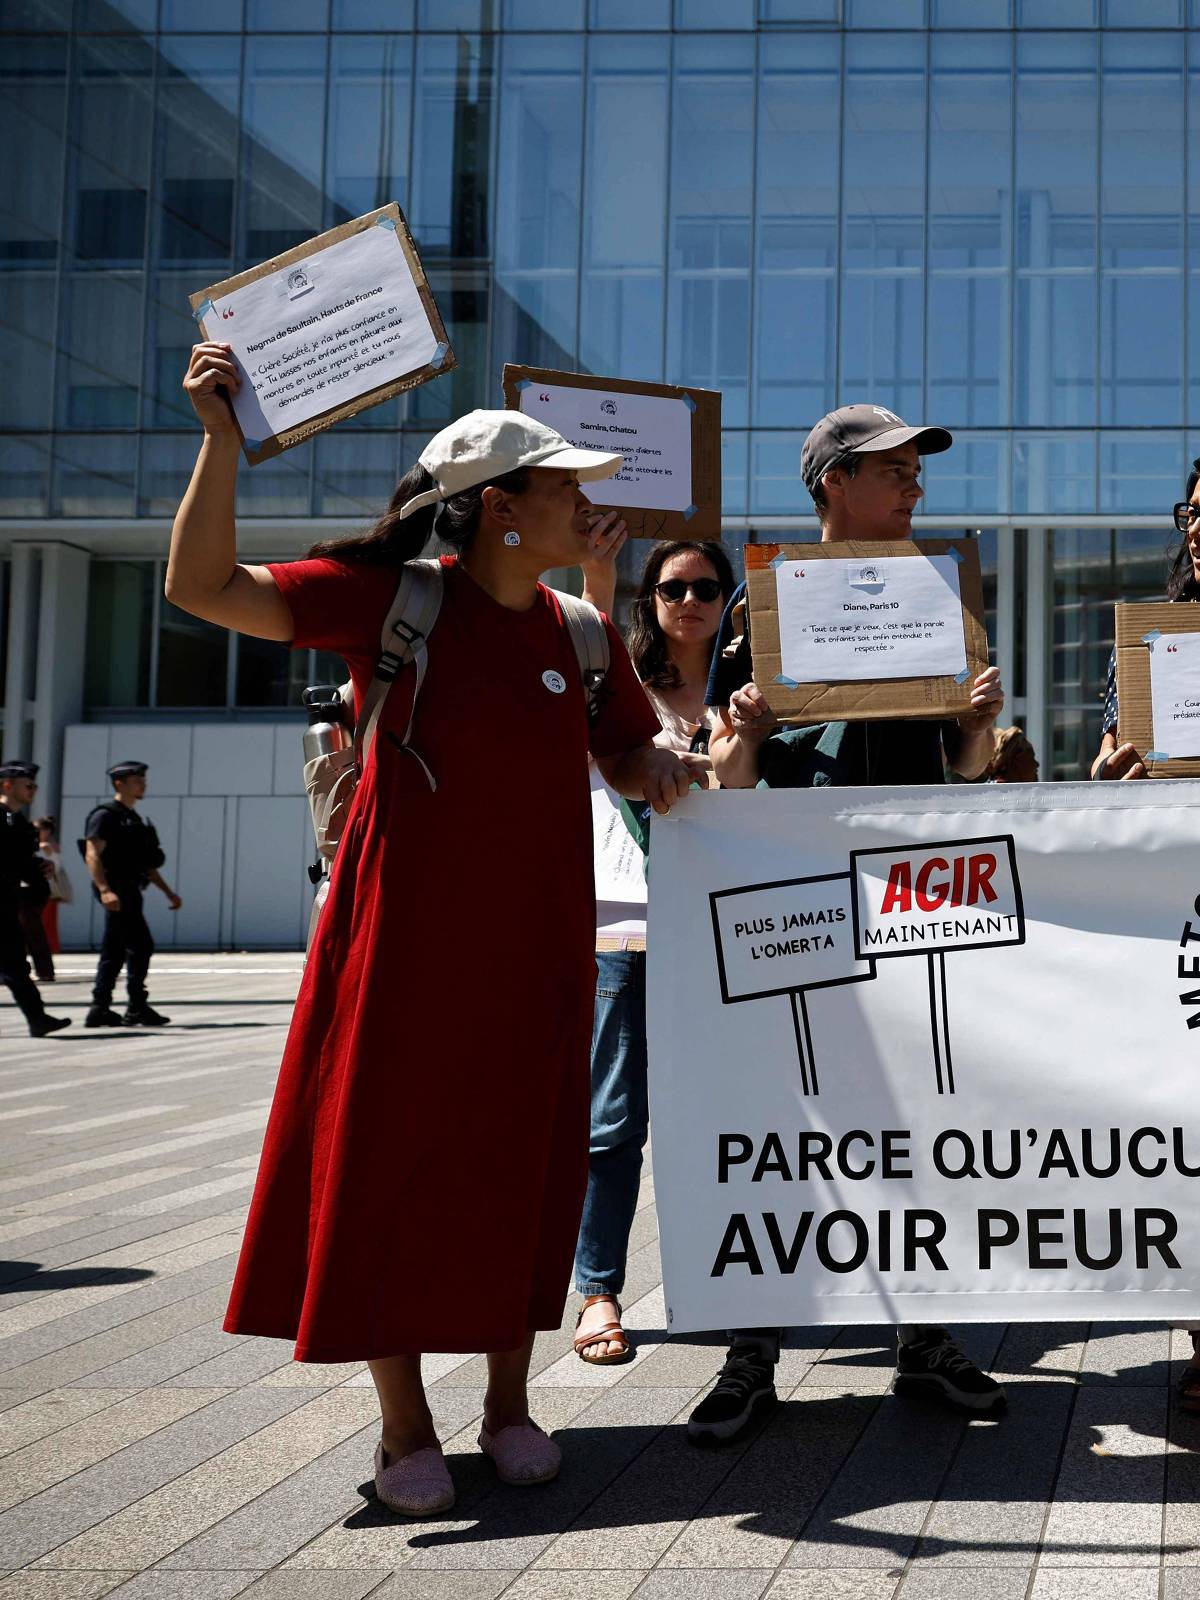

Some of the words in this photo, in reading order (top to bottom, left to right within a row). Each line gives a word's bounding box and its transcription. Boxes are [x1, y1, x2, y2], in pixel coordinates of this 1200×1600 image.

[246, 336, 276, 354] Negma
[275, 330, 287, 340] de
[286, 312, 321, 334] Saultain,
[319, 303, 345, 319] Hauts
[344, 299, 355, 308] de
[354, 286, 383, 303] France
[257, 359, 282, 374] Chère
[281, 343, 311, 363] Société,
[311, 340, 320, 353] je
[334, 327, 350, 340] plus
[350, 310, 386, 331] confiance
[387, 306, 398, 314] en
[264, 374, 278, 384] Tu
[278, 364, 302, 379] laisses
[302, 357, 317, 367] nos
[317, 342, 348, 361] enfants
[348, 338, 359, 346] en
[360, 324, 386, 343] pâture
[387, 317, 403, 328] aux
[263, 382, 295, 400] montres
[295, 377, 306, 386] en
[306, 366, 328, 380] toute
[328, 348, 359, 370] impunité
[360, 346, 370, 355] et
[371, 342, 382, 350] tu
[383, 332, 401, 344] nous
[278, 386, 315, 408] demandes
[316, 380, 326, 390] de
[327, 369, 351, 384] rester
[579, 422, 609, 433] Samira,
[608, 425, 637, 435] Chatou
[578, 440, 605, 450] Macron
[842, 603, 869, 611] Diane,
[869, 602, 890, 610] Paris
[889, 601, 899, 609] 10
[808, 624, 827, 633] Tout
[839, 625, 852, 633] que
[853, 624, 861, 633] je
[882, 622, 898, 630] c'est
[900, 622, 914, 630] que
[923, 620, 945, 629] parole
[828, 635, 856, 643] enfants
[872, 633, 890, 641] enfin
[891, 631, 922, 640] entendue
[854, 642, 888, 653] respectée
[880, 853, 998, 915] AGIR
[734, 916, 775, 938] PLUS
[782, 907, 847, 933] JAMAIS
[864, 914, 1017, 946] MAINTENANT
[751, 934, 835, 960] L'OMERTA
[717, 1130, 914, 1184] PARCE
[709, 1207, 950, 1277] AVOIR
[977, 1207, 1183, 1272] PEUR
